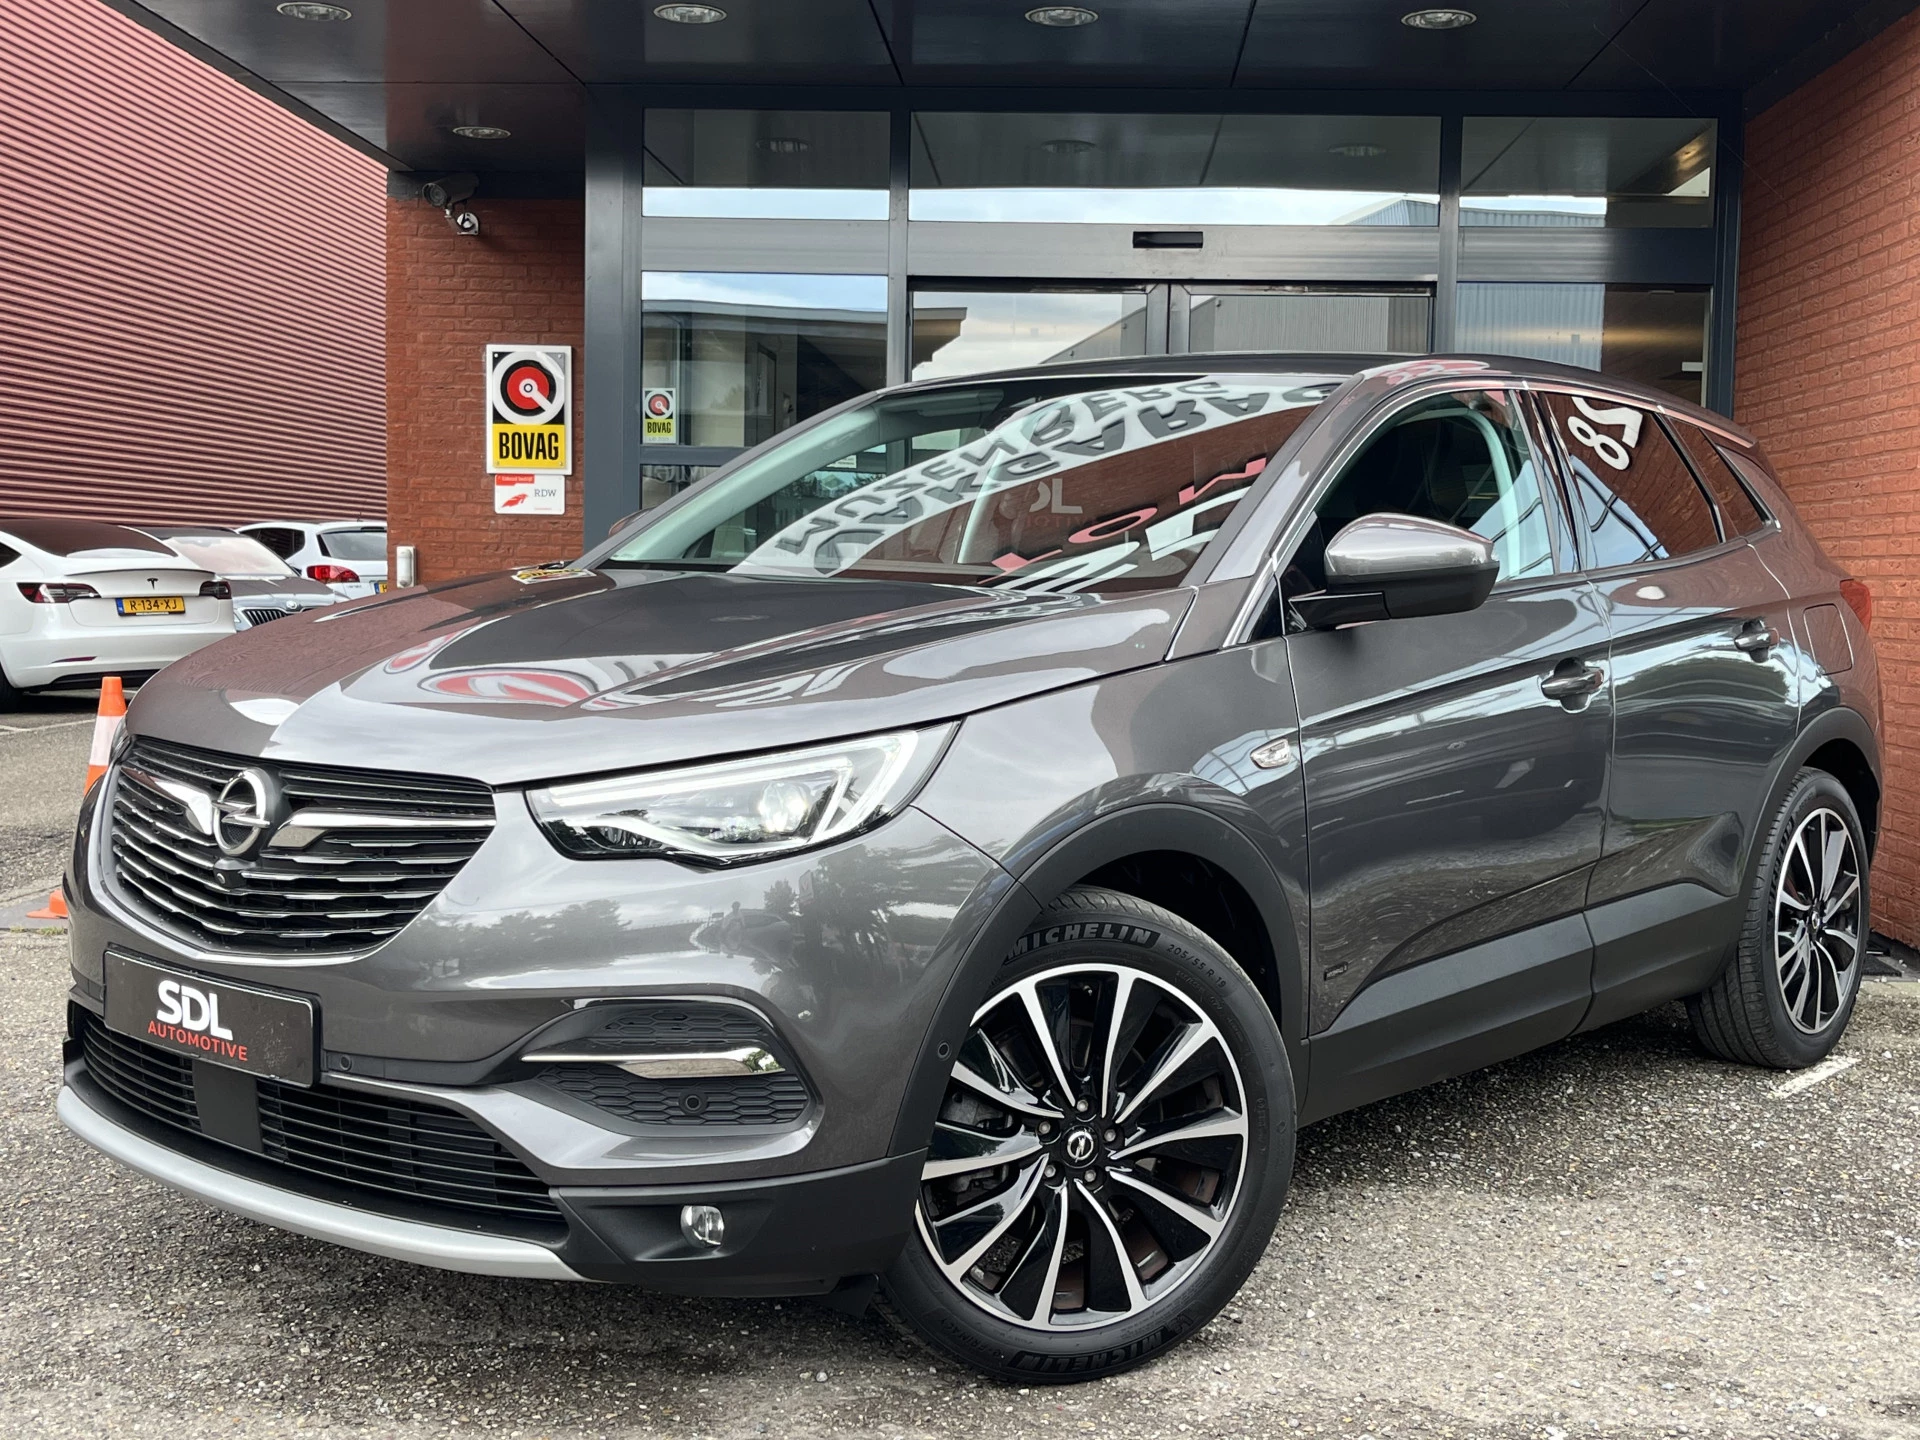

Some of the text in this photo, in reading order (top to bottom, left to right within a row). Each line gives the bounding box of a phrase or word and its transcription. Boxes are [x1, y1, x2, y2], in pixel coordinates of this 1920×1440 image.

[647, 421, 672, 434] BOVAG
[499, 432, 559, 460] BOVAG
[534, 489, 557, 497] RDW
[130, 599, 177, 611] R-134-XJ
[1007, 923, 1152, 958] MICHELIN
[1166, 944, 1207, 970] 205/55
[156, 979, 233, 1041] SDL
[148, 1020, 248, 1061] AUTOMOTIVE
[1017, 1332, 1163, 1372] MICHELIN
